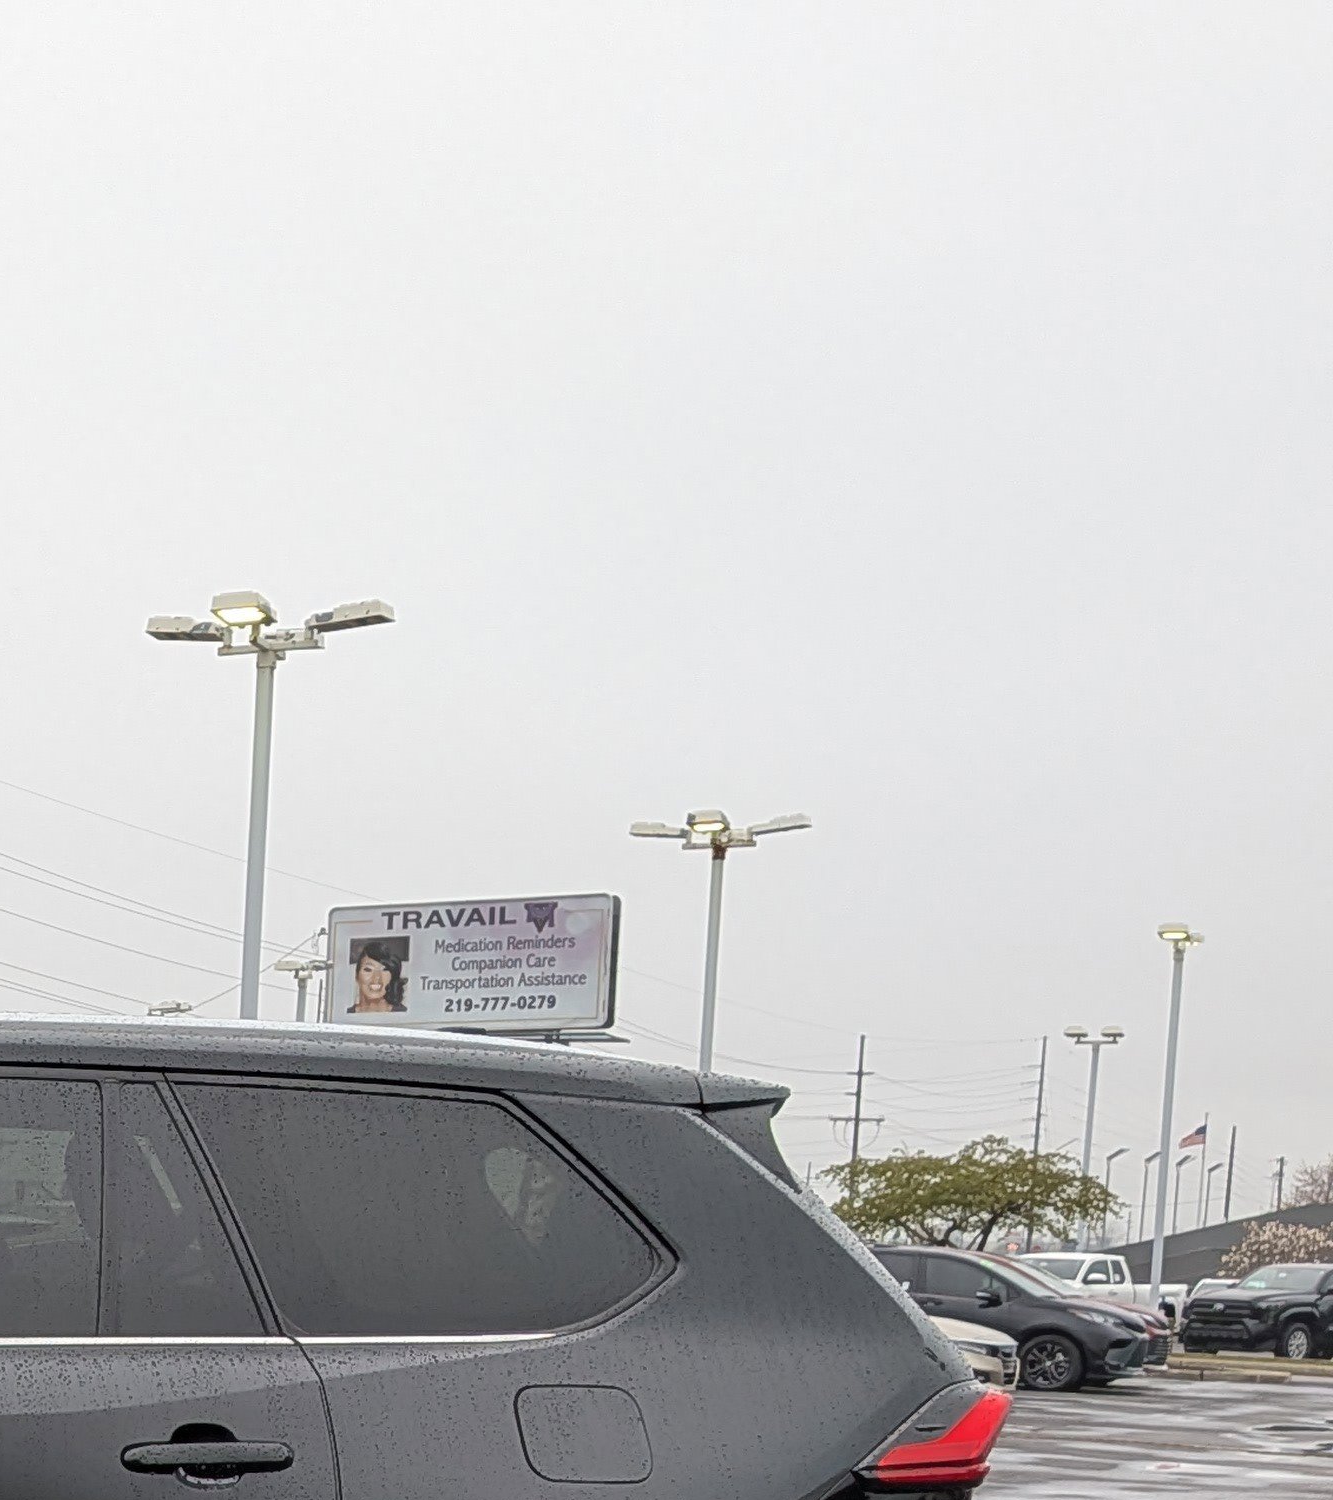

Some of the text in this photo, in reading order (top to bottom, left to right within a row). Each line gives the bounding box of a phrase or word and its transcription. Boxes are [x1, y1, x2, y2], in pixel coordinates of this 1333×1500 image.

[381, 906, 517, 930] TRAVAIL
[434, 935, 576, 954] Medication Reminders
[451, 954, 556, 973] Companion Care
[420, 971, 587, 993] Transportation Assistance
[444, 995, 557, 1012] 219-777-0279
